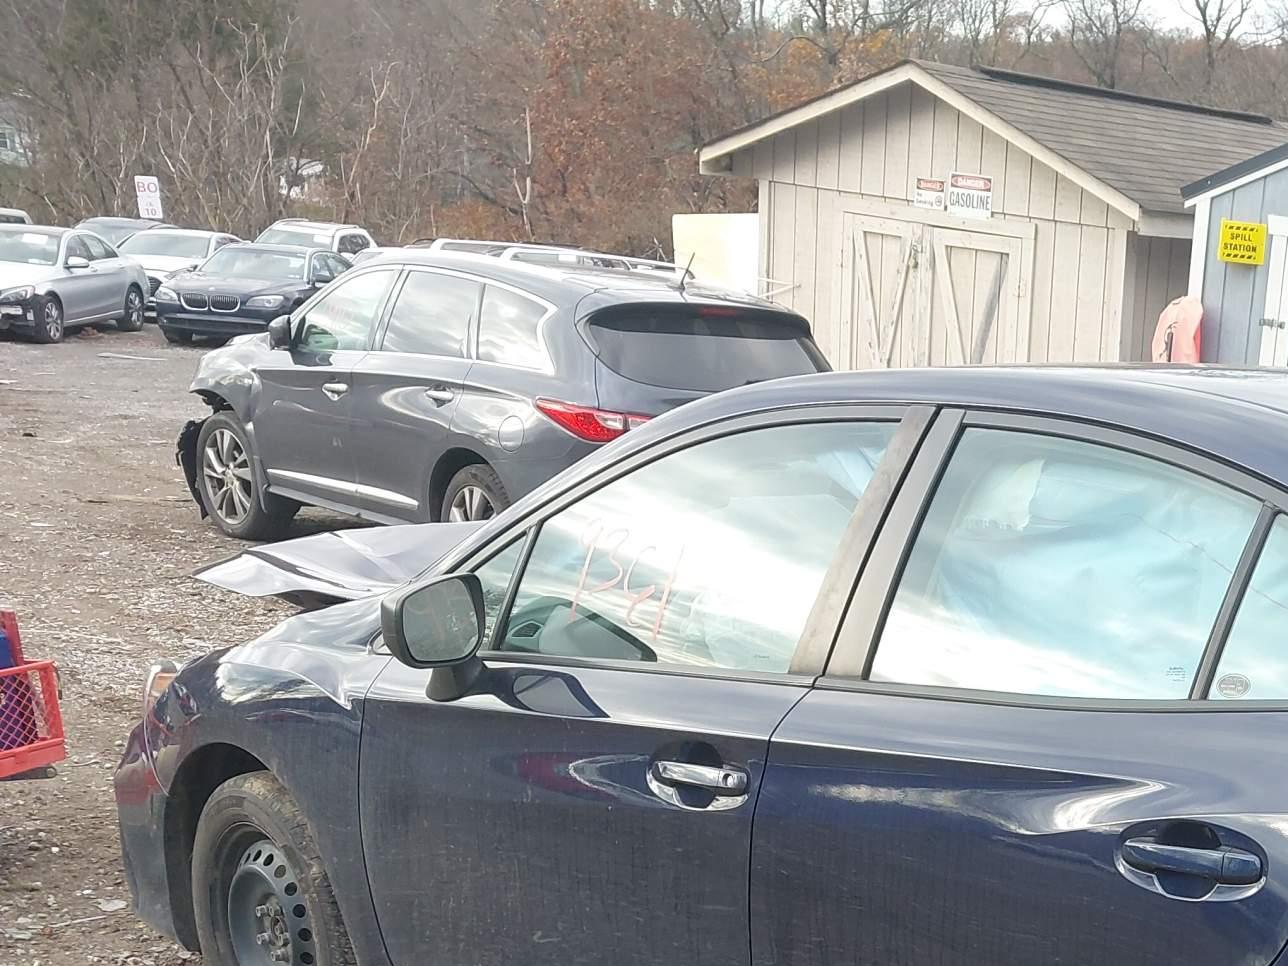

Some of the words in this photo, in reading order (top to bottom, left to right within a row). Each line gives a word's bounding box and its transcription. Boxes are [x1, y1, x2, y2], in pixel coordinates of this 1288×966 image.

[949, 191, 990, 211] GASOLINE
[1230, 232, 1253, 242] SPILL
[1223, 243, 1257, 253] STATION
